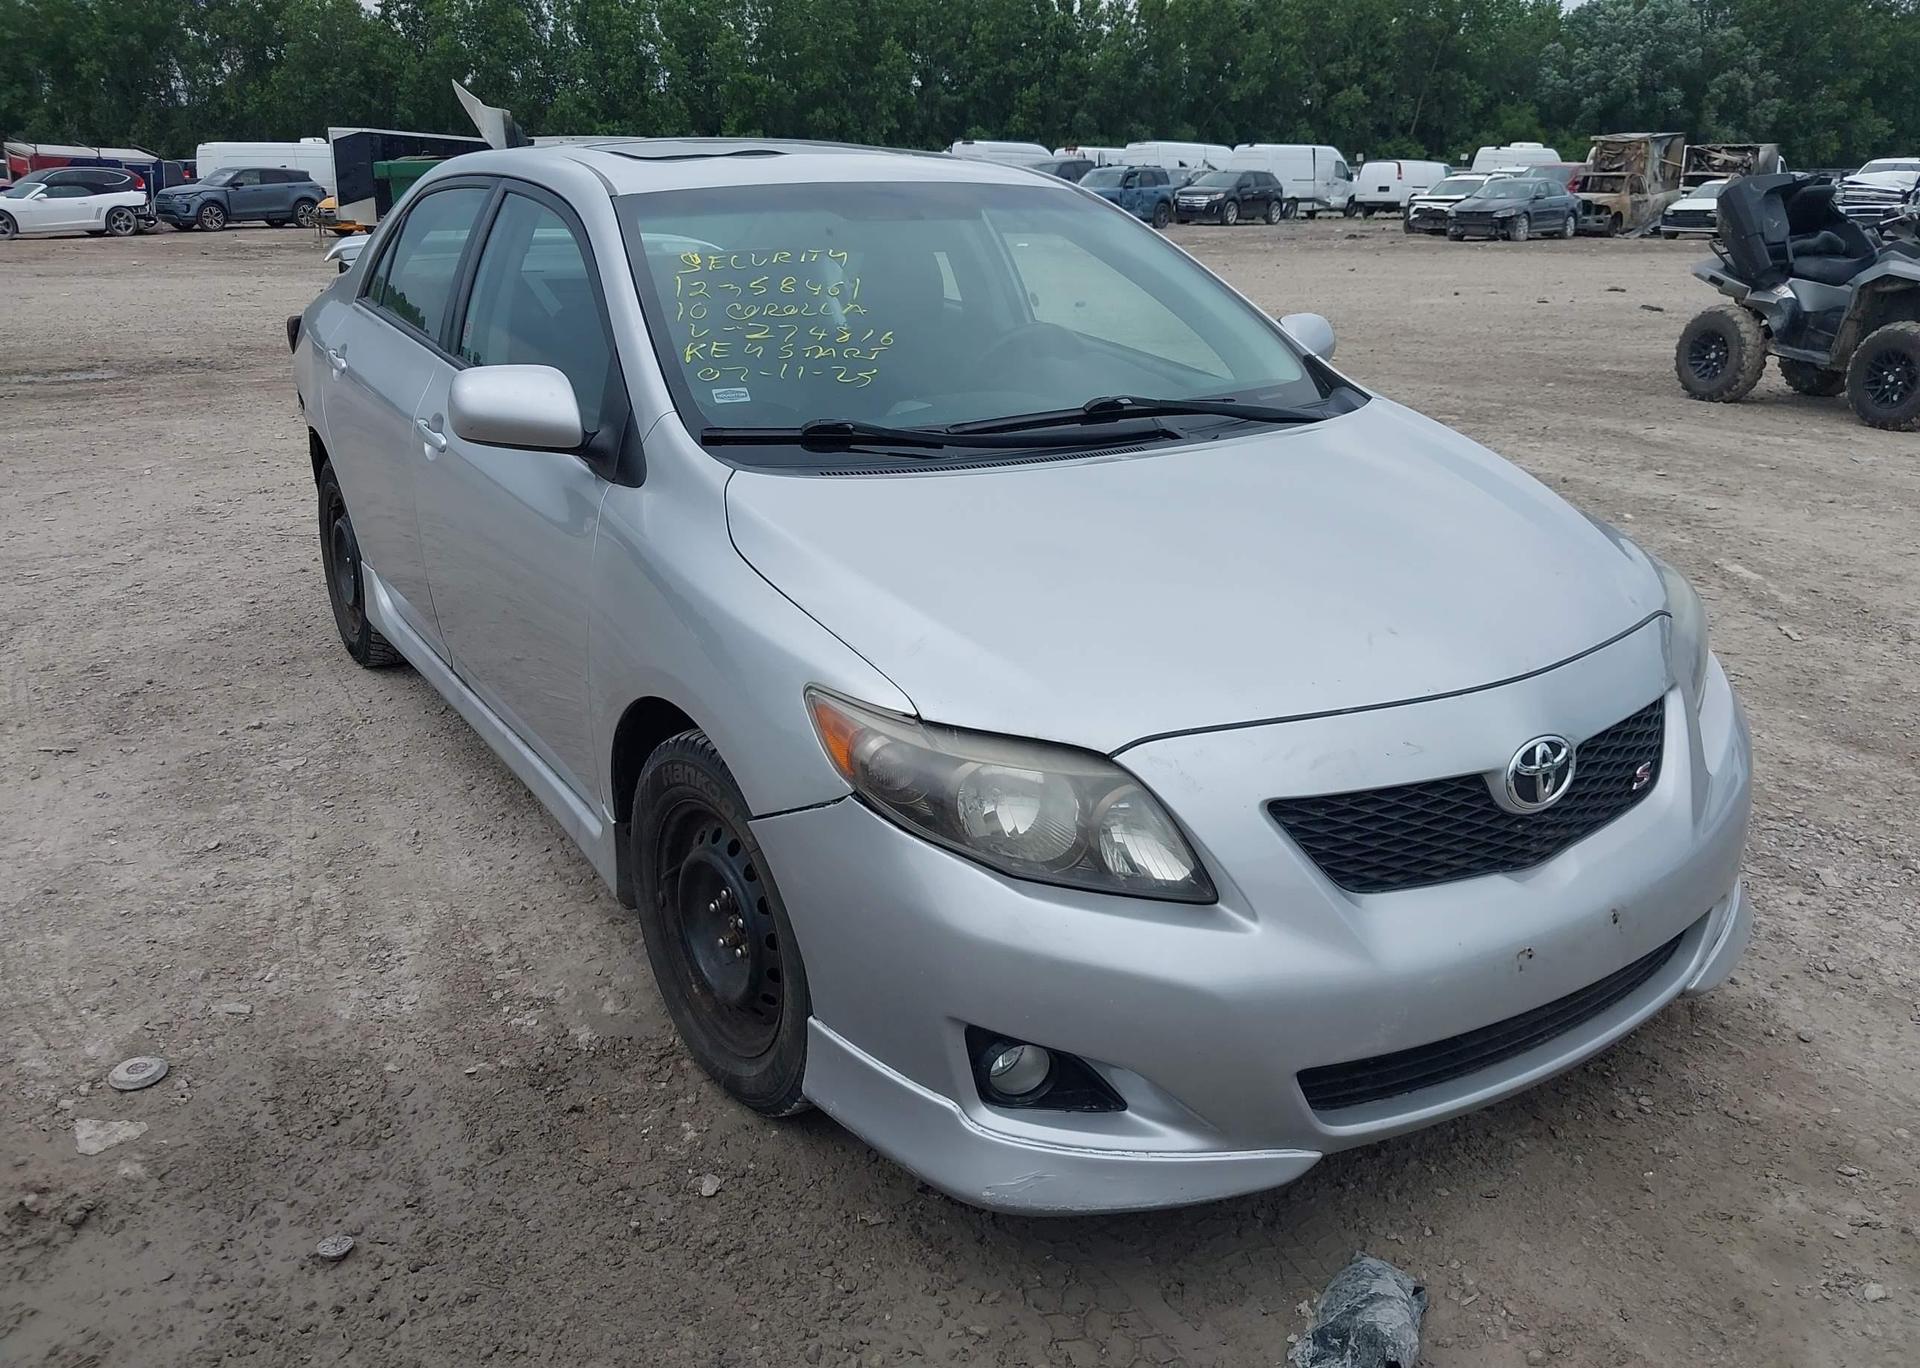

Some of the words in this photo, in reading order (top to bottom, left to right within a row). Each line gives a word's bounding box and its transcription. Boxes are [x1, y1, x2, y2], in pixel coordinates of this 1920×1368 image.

[679, 249, 848, 273] SECURITY
[676, 302, 708, 321] 10
[724, 303, 868, 320] COROLLA
[697, 363, 878, 388] 07-11-25
